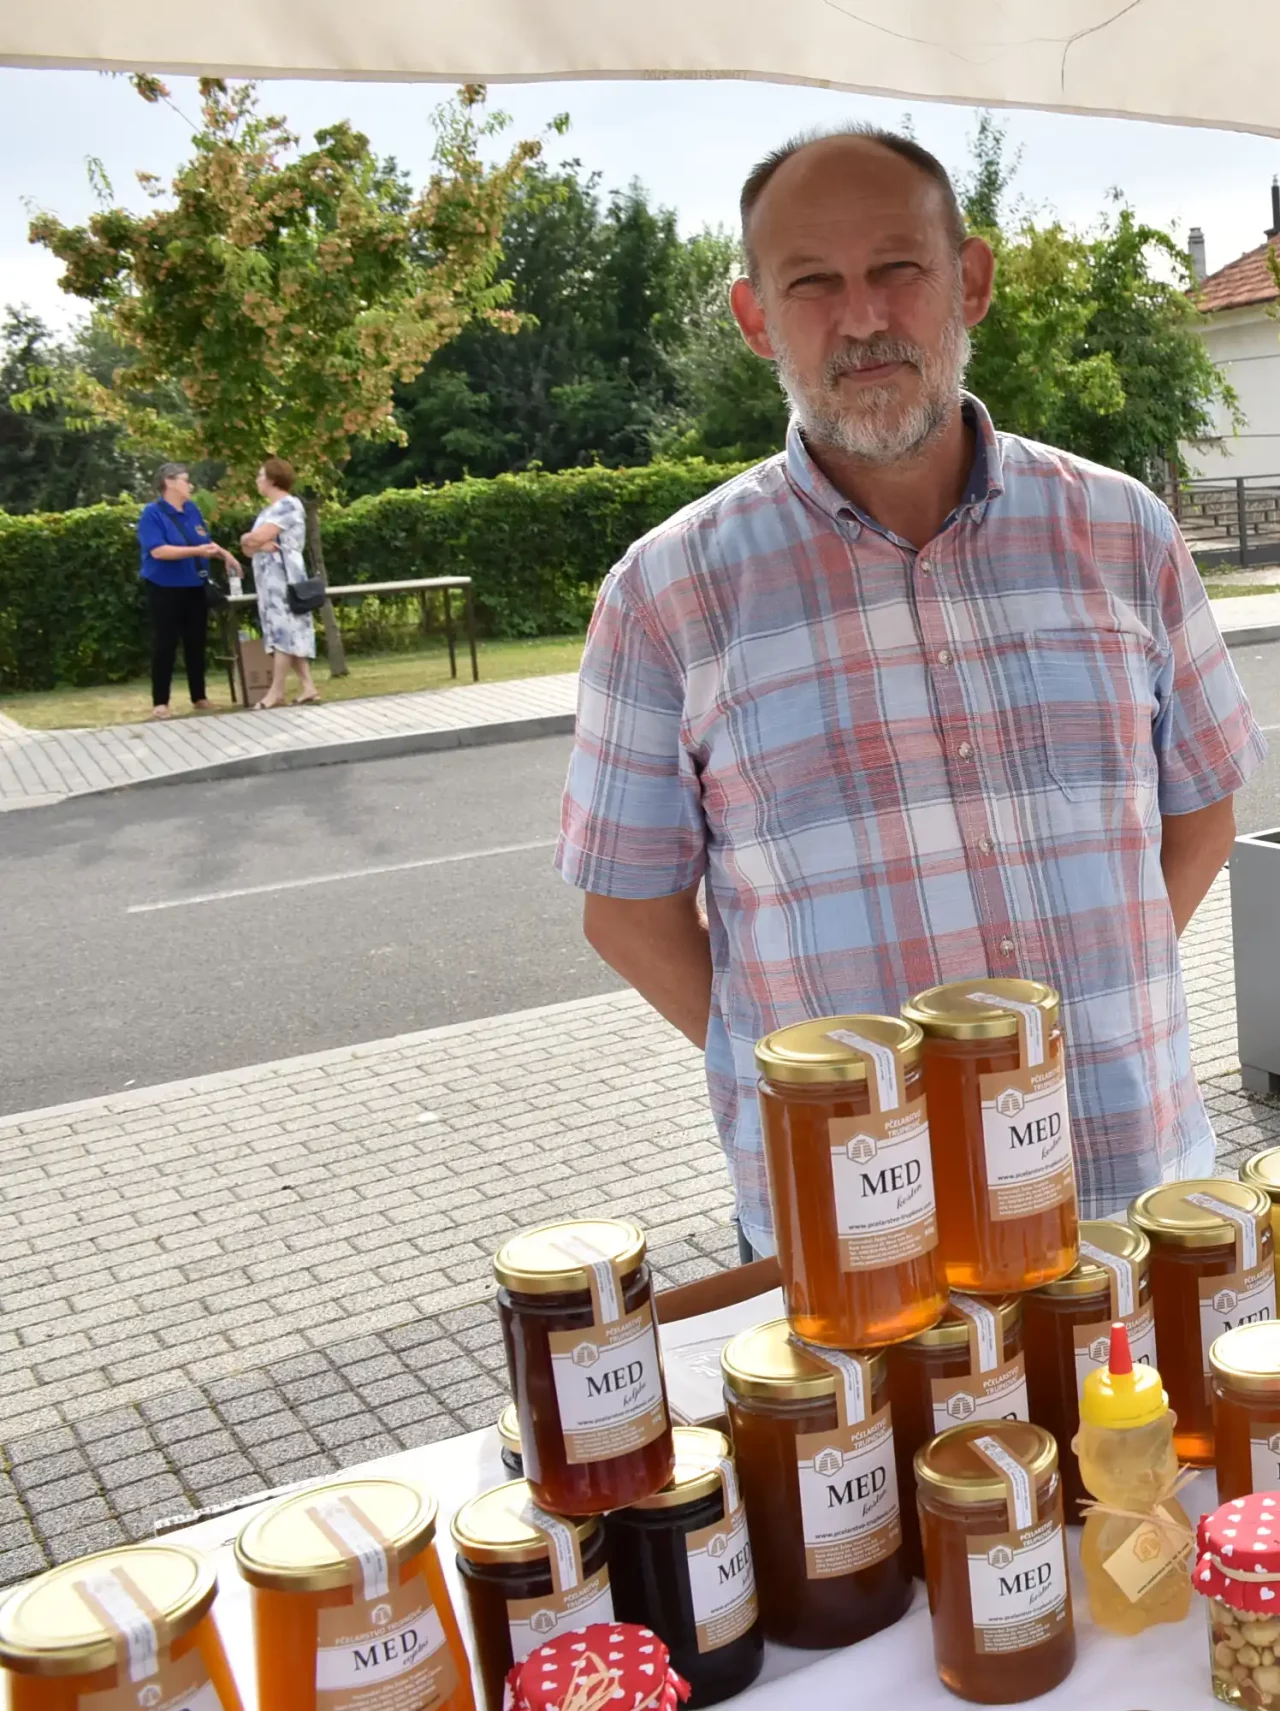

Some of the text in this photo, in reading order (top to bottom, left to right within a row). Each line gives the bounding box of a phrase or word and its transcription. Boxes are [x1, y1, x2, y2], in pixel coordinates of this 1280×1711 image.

[1008, 1112, 1061, 1149] MED
[859, 1159, 921, 1197] MED
[586, 1360, 644, 1398] MED
[826, 1466, 886, 1508] MED
[998, 1562, 1052, 1597] MED
[352, 1629, 418, 1671] MED
